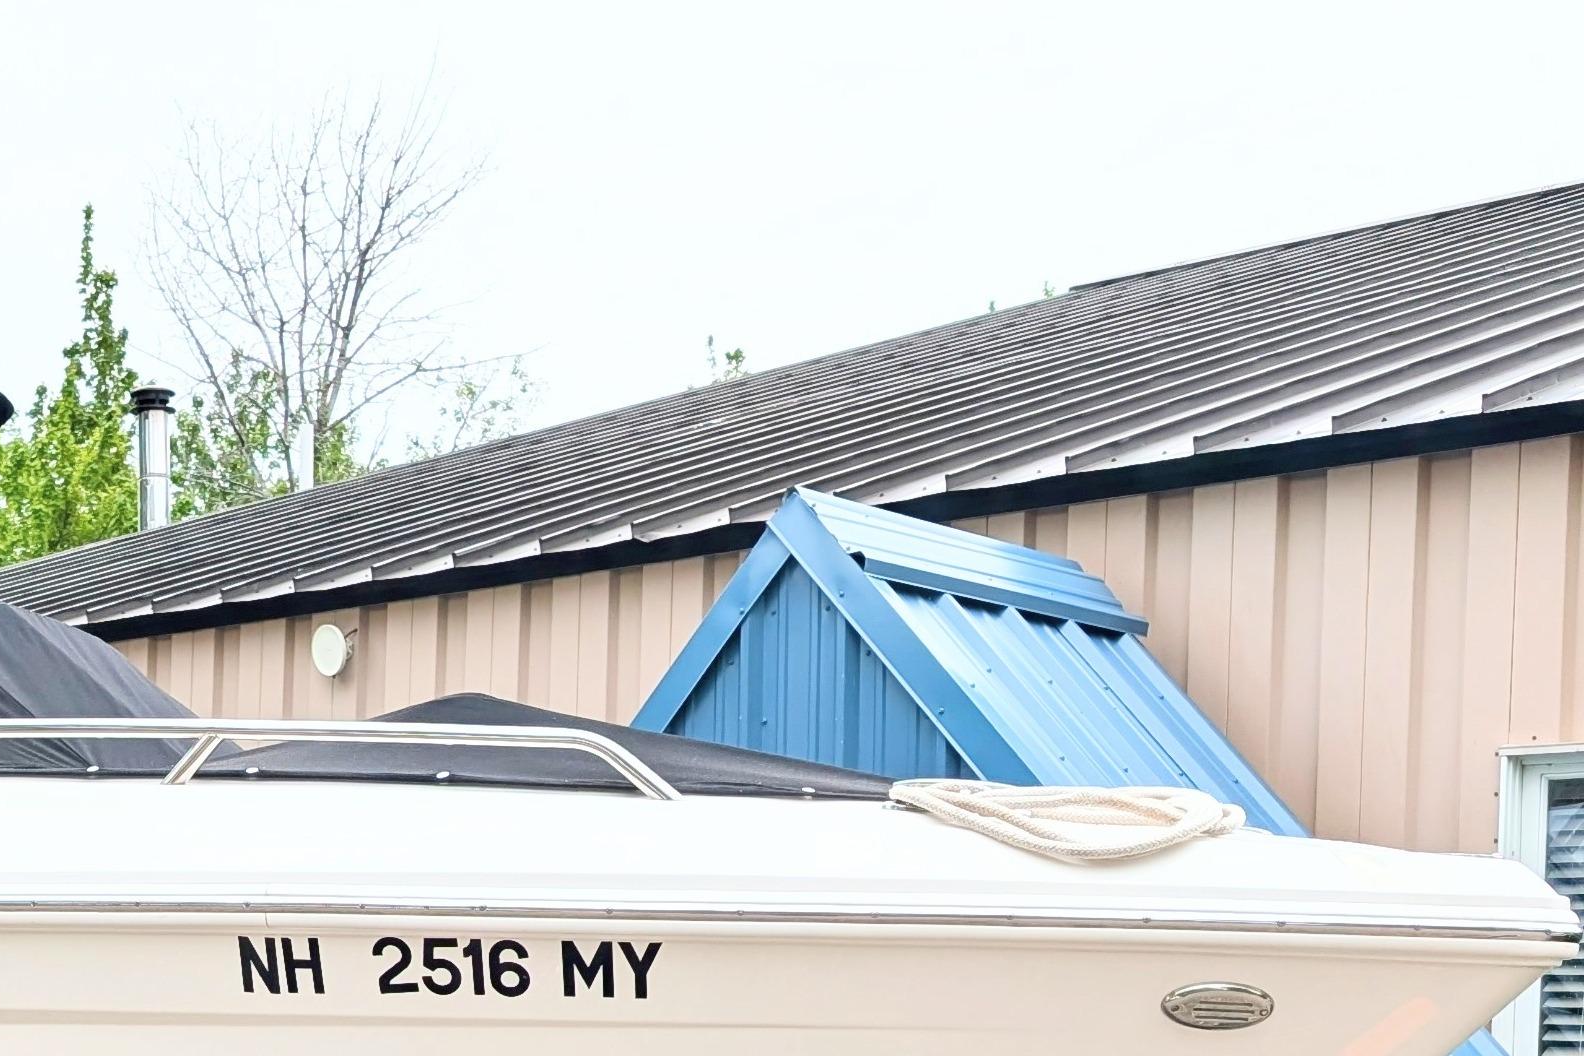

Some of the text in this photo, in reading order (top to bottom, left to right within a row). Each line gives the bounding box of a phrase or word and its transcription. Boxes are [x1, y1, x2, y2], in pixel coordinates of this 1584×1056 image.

[238, 936, 663, 999] NH 2516 MY
